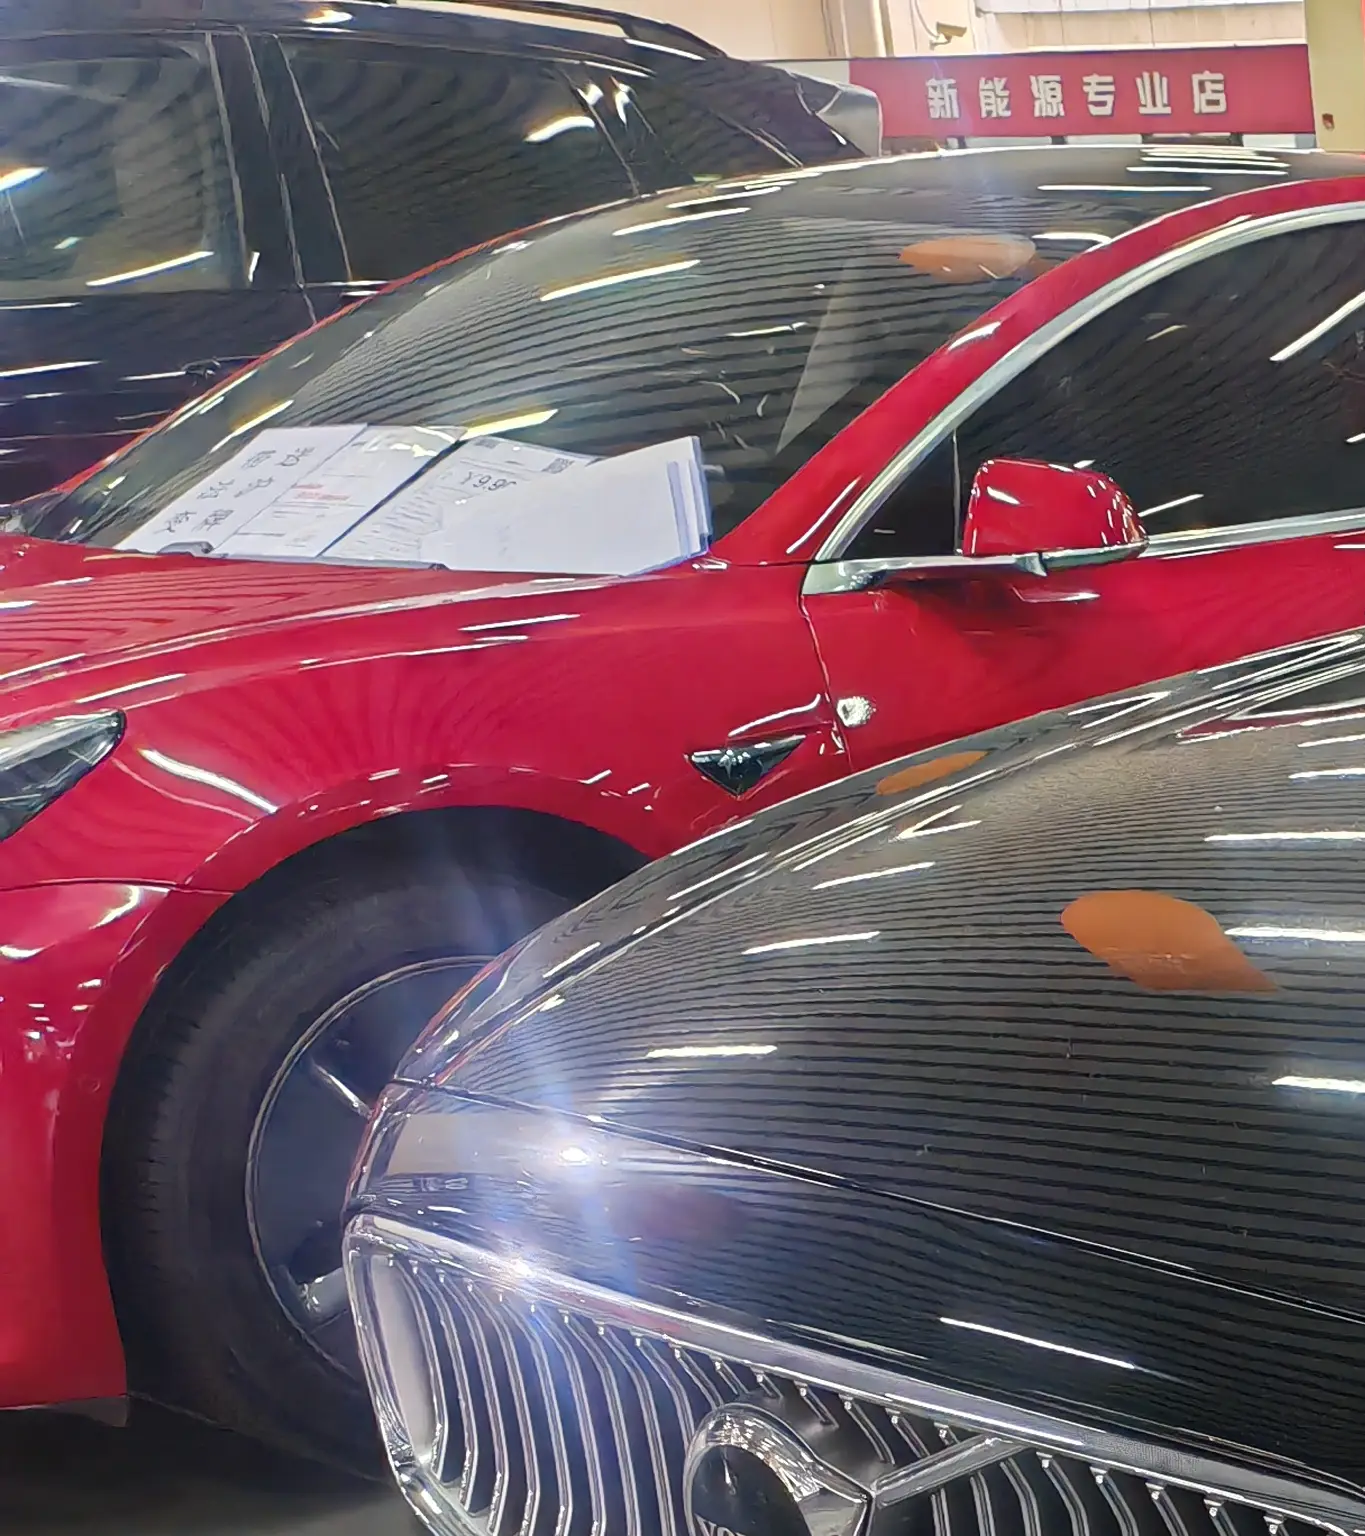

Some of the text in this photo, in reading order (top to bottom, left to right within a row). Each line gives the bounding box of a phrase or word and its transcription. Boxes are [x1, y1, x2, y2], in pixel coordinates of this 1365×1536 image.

[925, 70, 1228, 119] 新能源专业店
